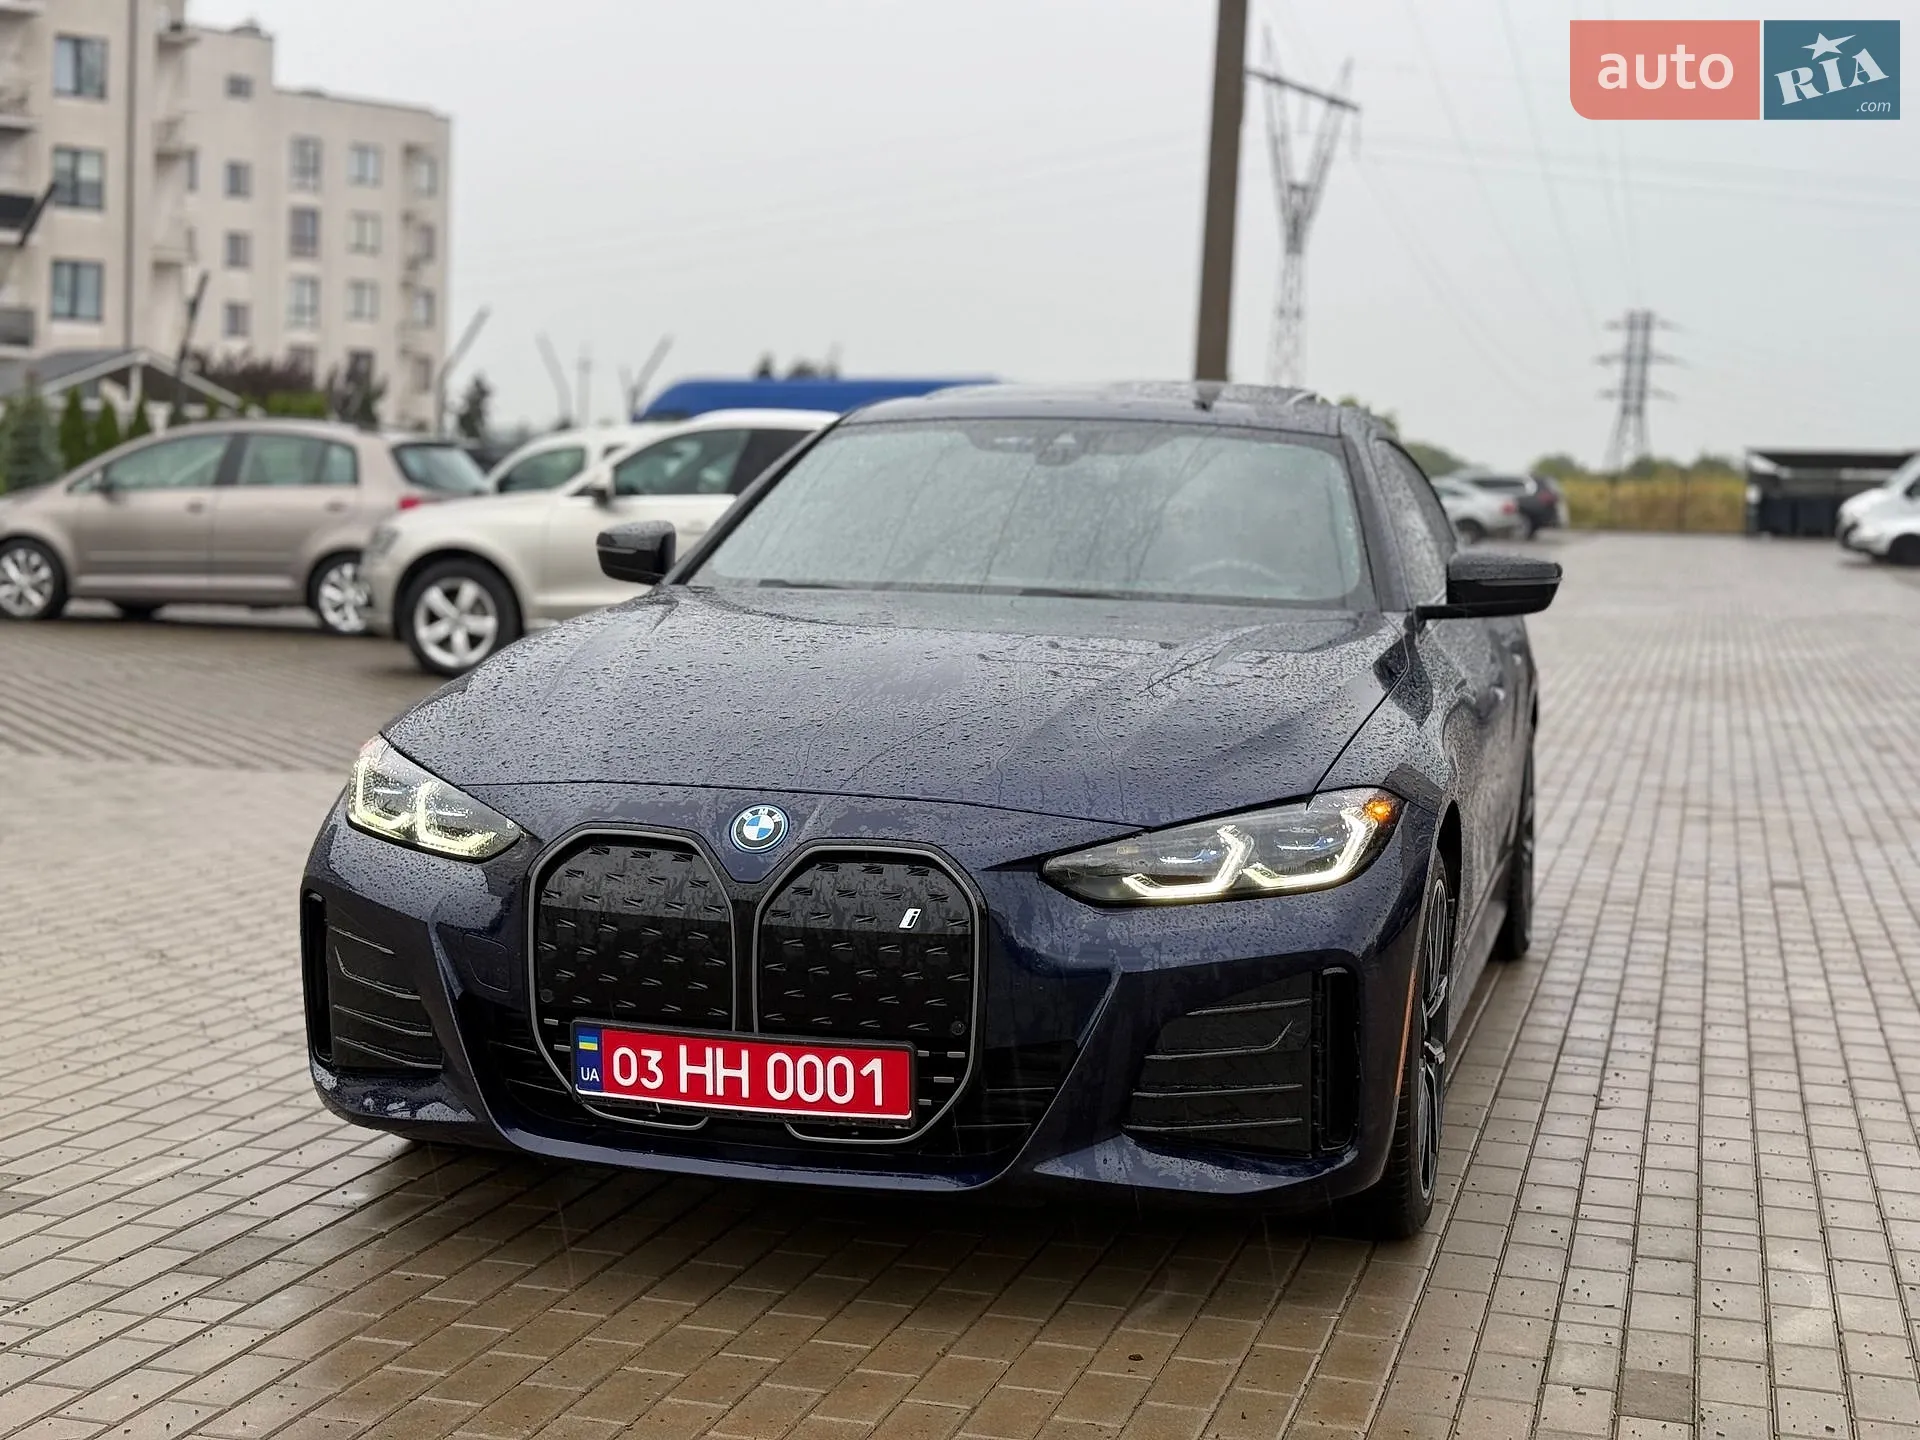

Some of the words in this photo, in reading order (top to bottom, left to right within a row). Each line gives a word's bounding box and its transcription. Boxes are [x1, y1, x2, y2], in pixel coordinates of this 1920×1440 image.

[742, 808, 782, 823] BMW
[580, 1066, 600, 1083] UA
[612, 1046, 664, 1090] 03
[679, 1044, 749, 1099] HH
[766, 1052, 883, 1107] 0001
